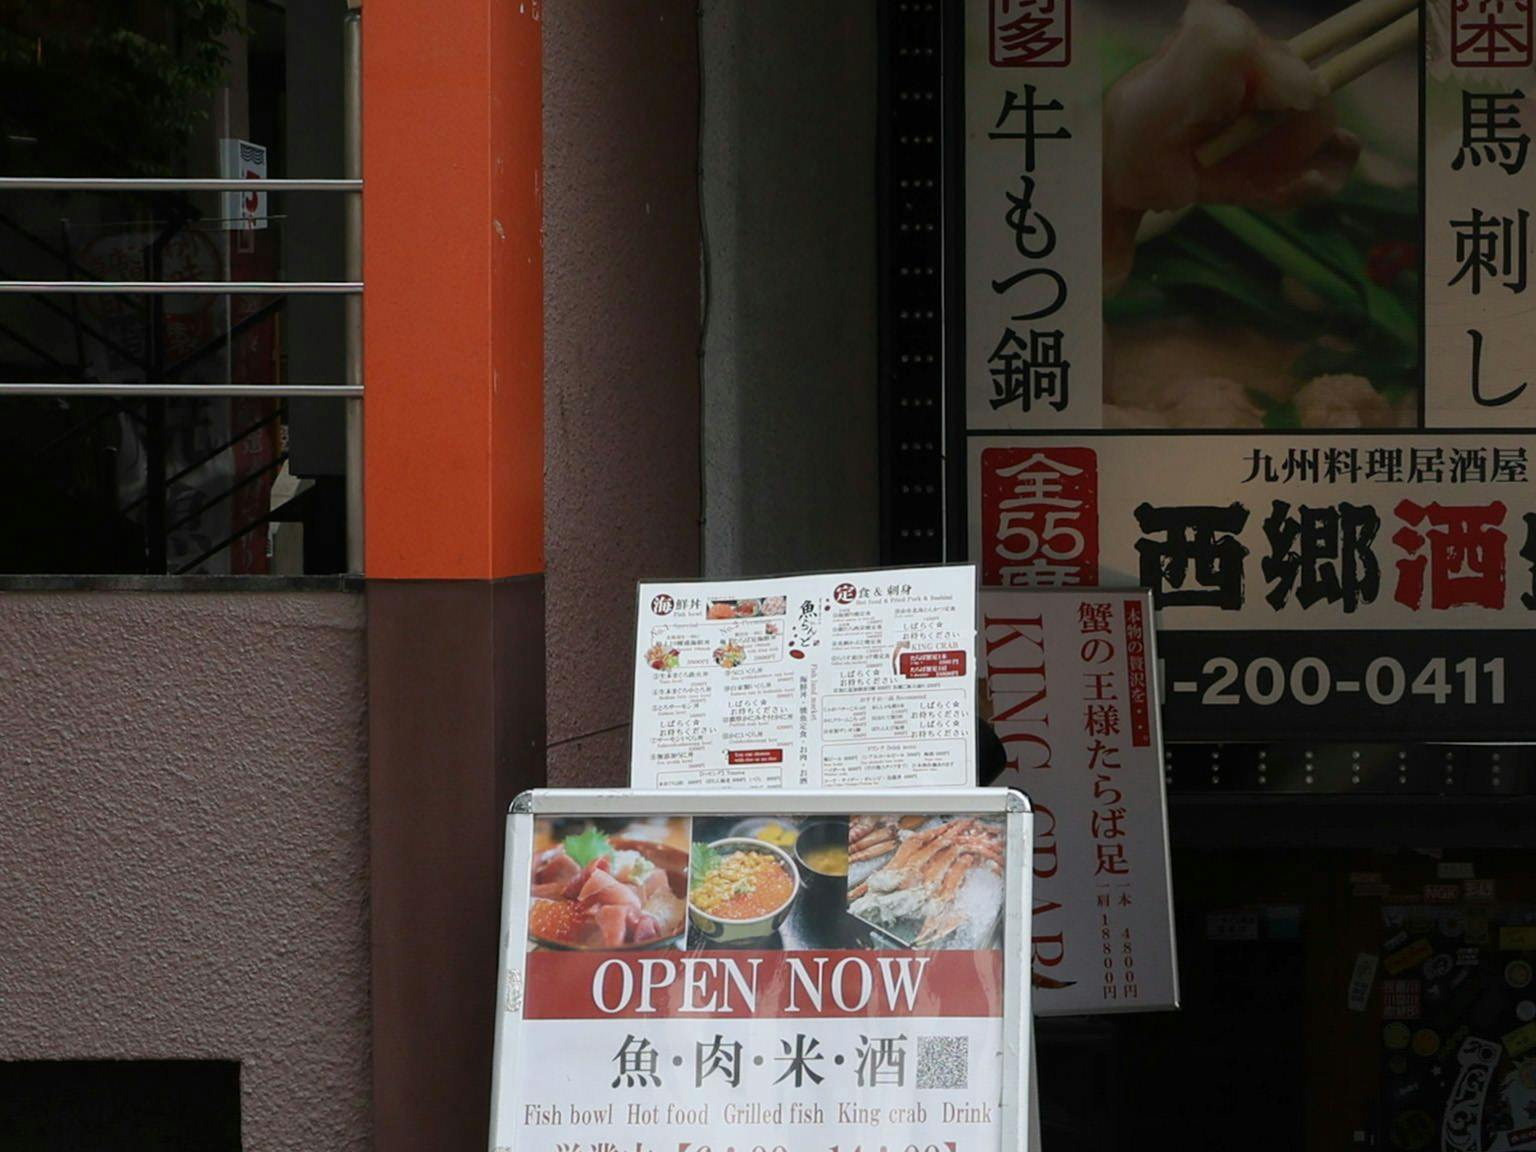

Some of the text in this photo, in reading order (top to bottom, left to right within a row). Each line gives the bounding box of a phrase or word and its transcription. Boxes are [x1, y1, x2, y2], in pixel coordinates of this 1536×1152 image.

[988, 84, 1072, 412] 牛もつ鍋
[1448, 89, 1531, 408] 馬刺し
[1241, 447, 1529, 484] 九州料理居酒屋
[984, 613, 1053, 773] KING
[1161, 656, 1506, 706] -200-0411
[1077, 601, 1130, 876] 蟹の王様たらば足
[592, 956, 931, 1014] OPEN NOW
[610, 1033, 907, 1091] 魚・肉・米・酒
[524, 1102, 992, 1127] Fish bowl Hot food Grilled fish King crab Drink
